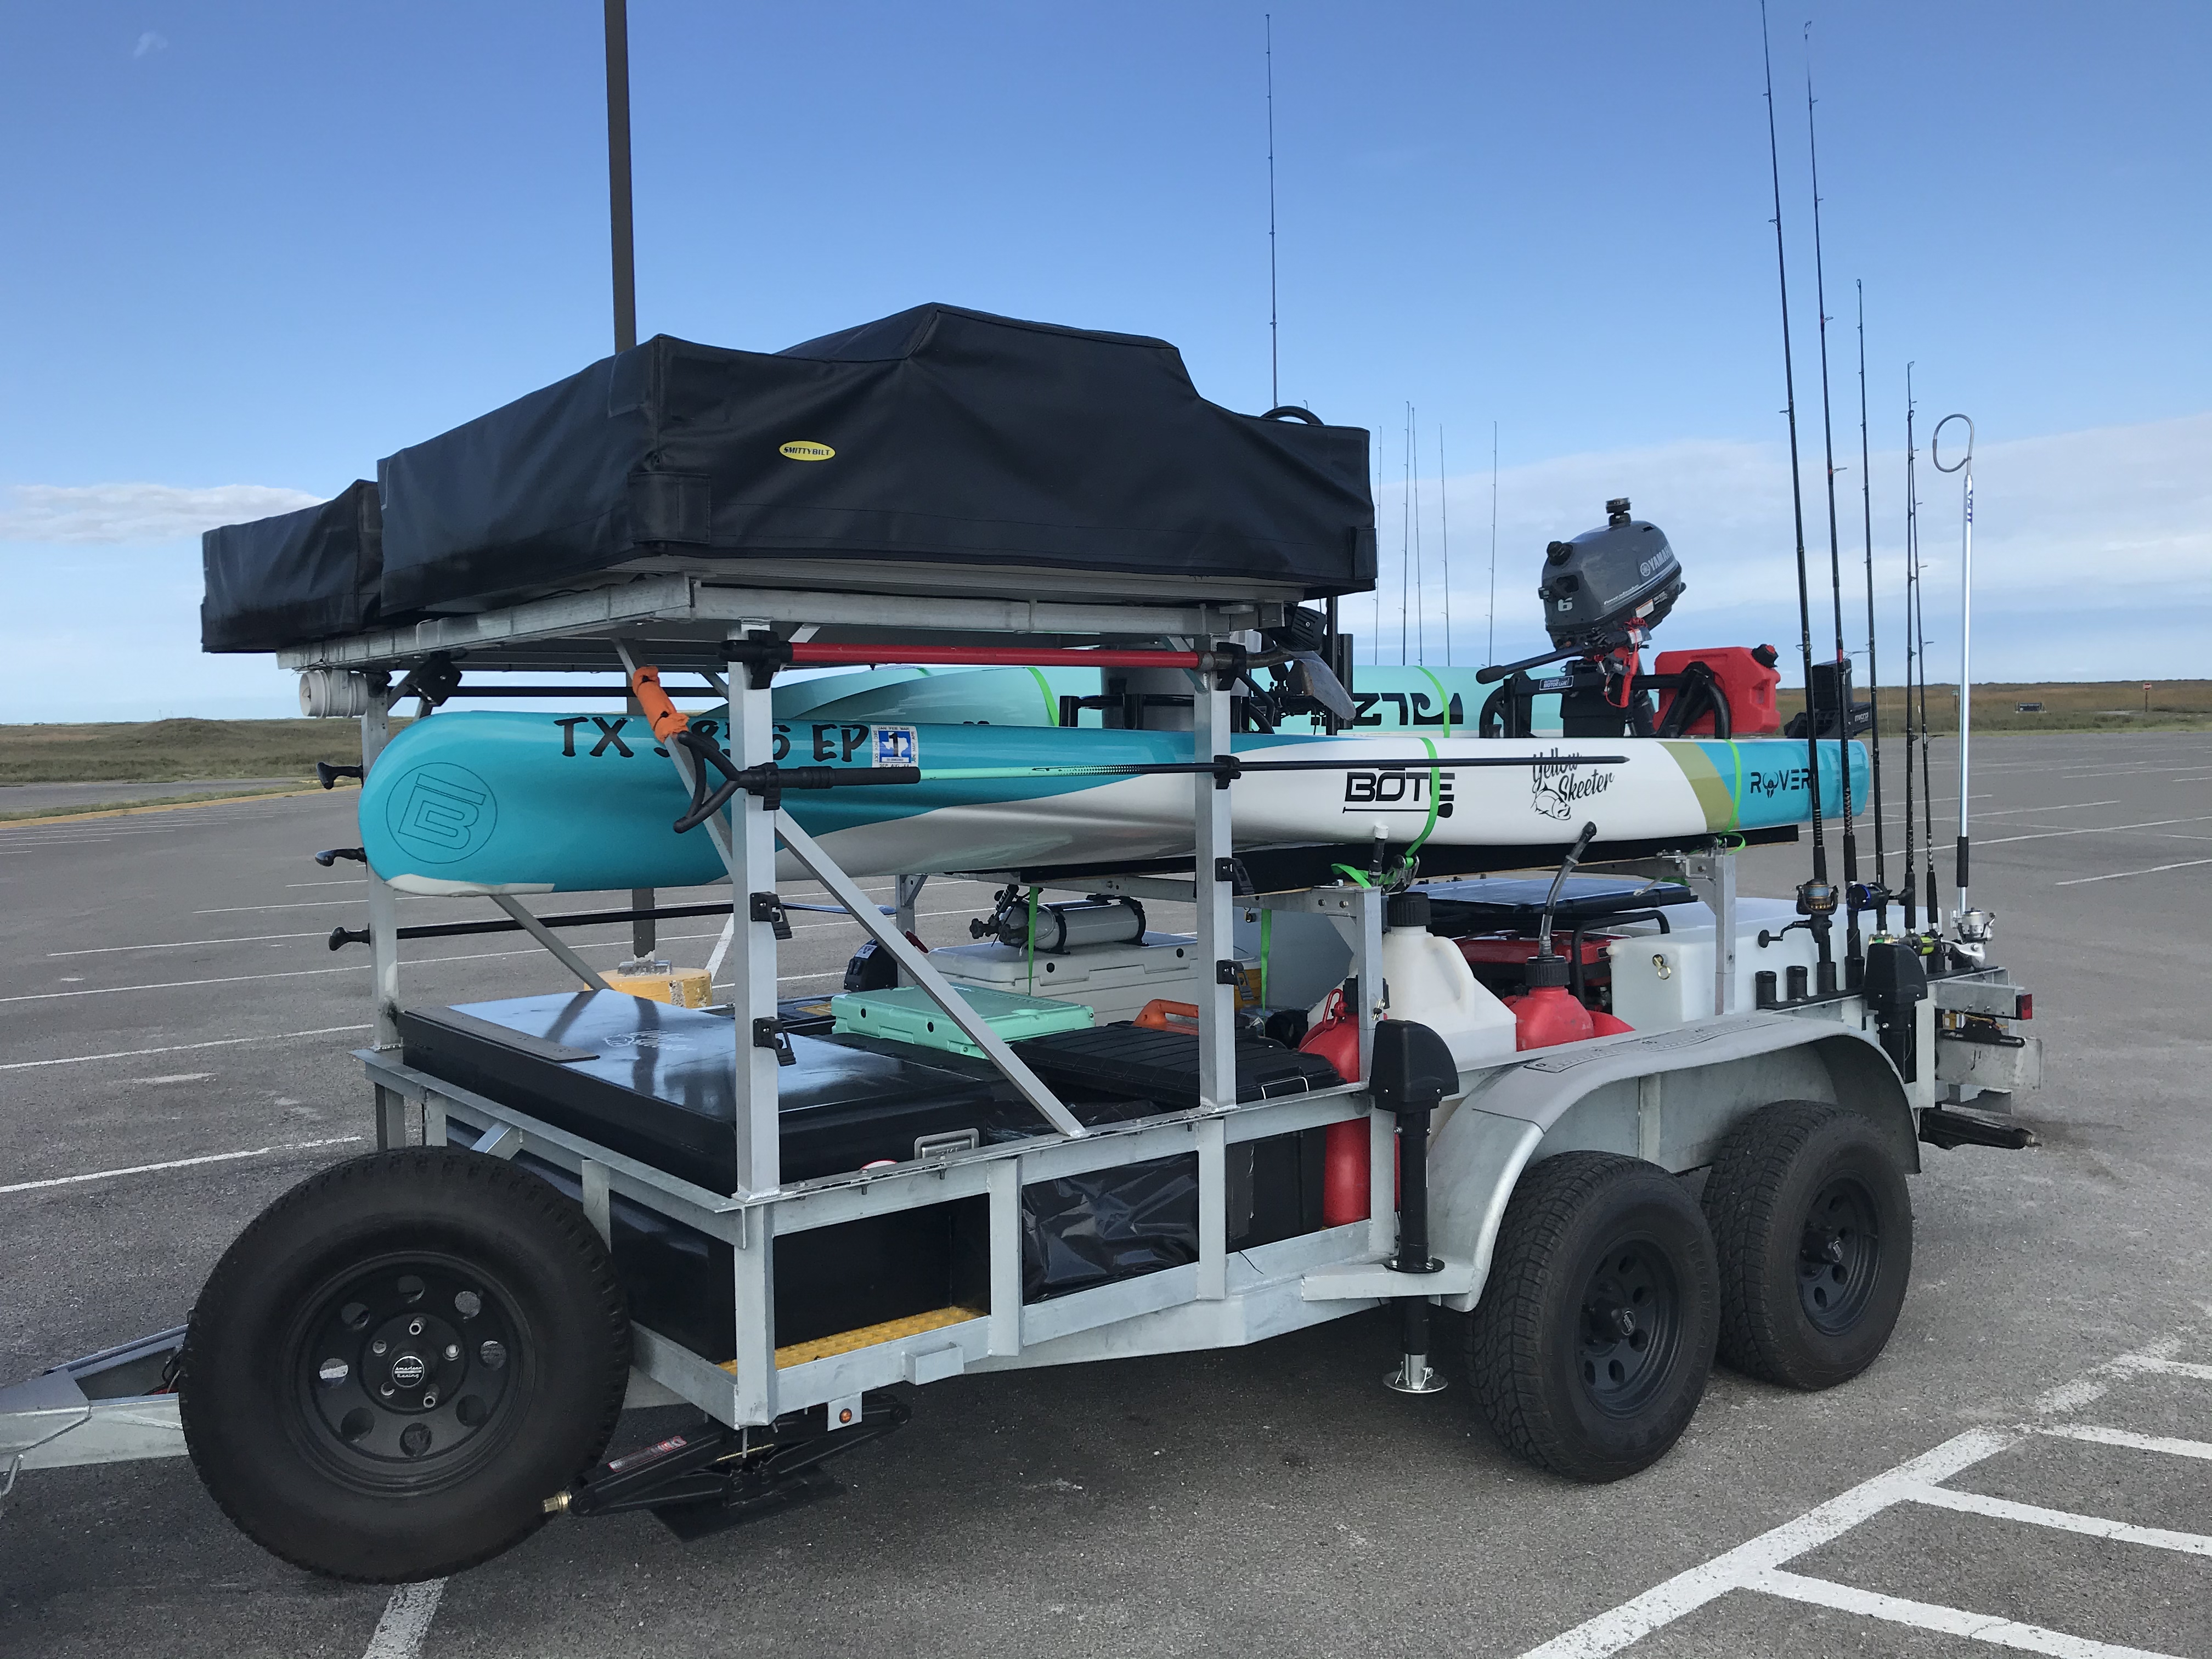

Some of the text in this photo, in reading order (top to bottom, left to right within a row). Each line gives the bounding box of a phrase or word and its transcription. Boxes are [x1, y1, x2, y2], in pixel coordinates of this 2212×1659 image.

[783, 446, 831, 456] SMITTYBILT
[1558, 597, 1573, 612] 6
[554, 716, 635, 758] TX
[812, 724, 870, 763] EP
[1558, 769, 1615, 802] Skeeter
